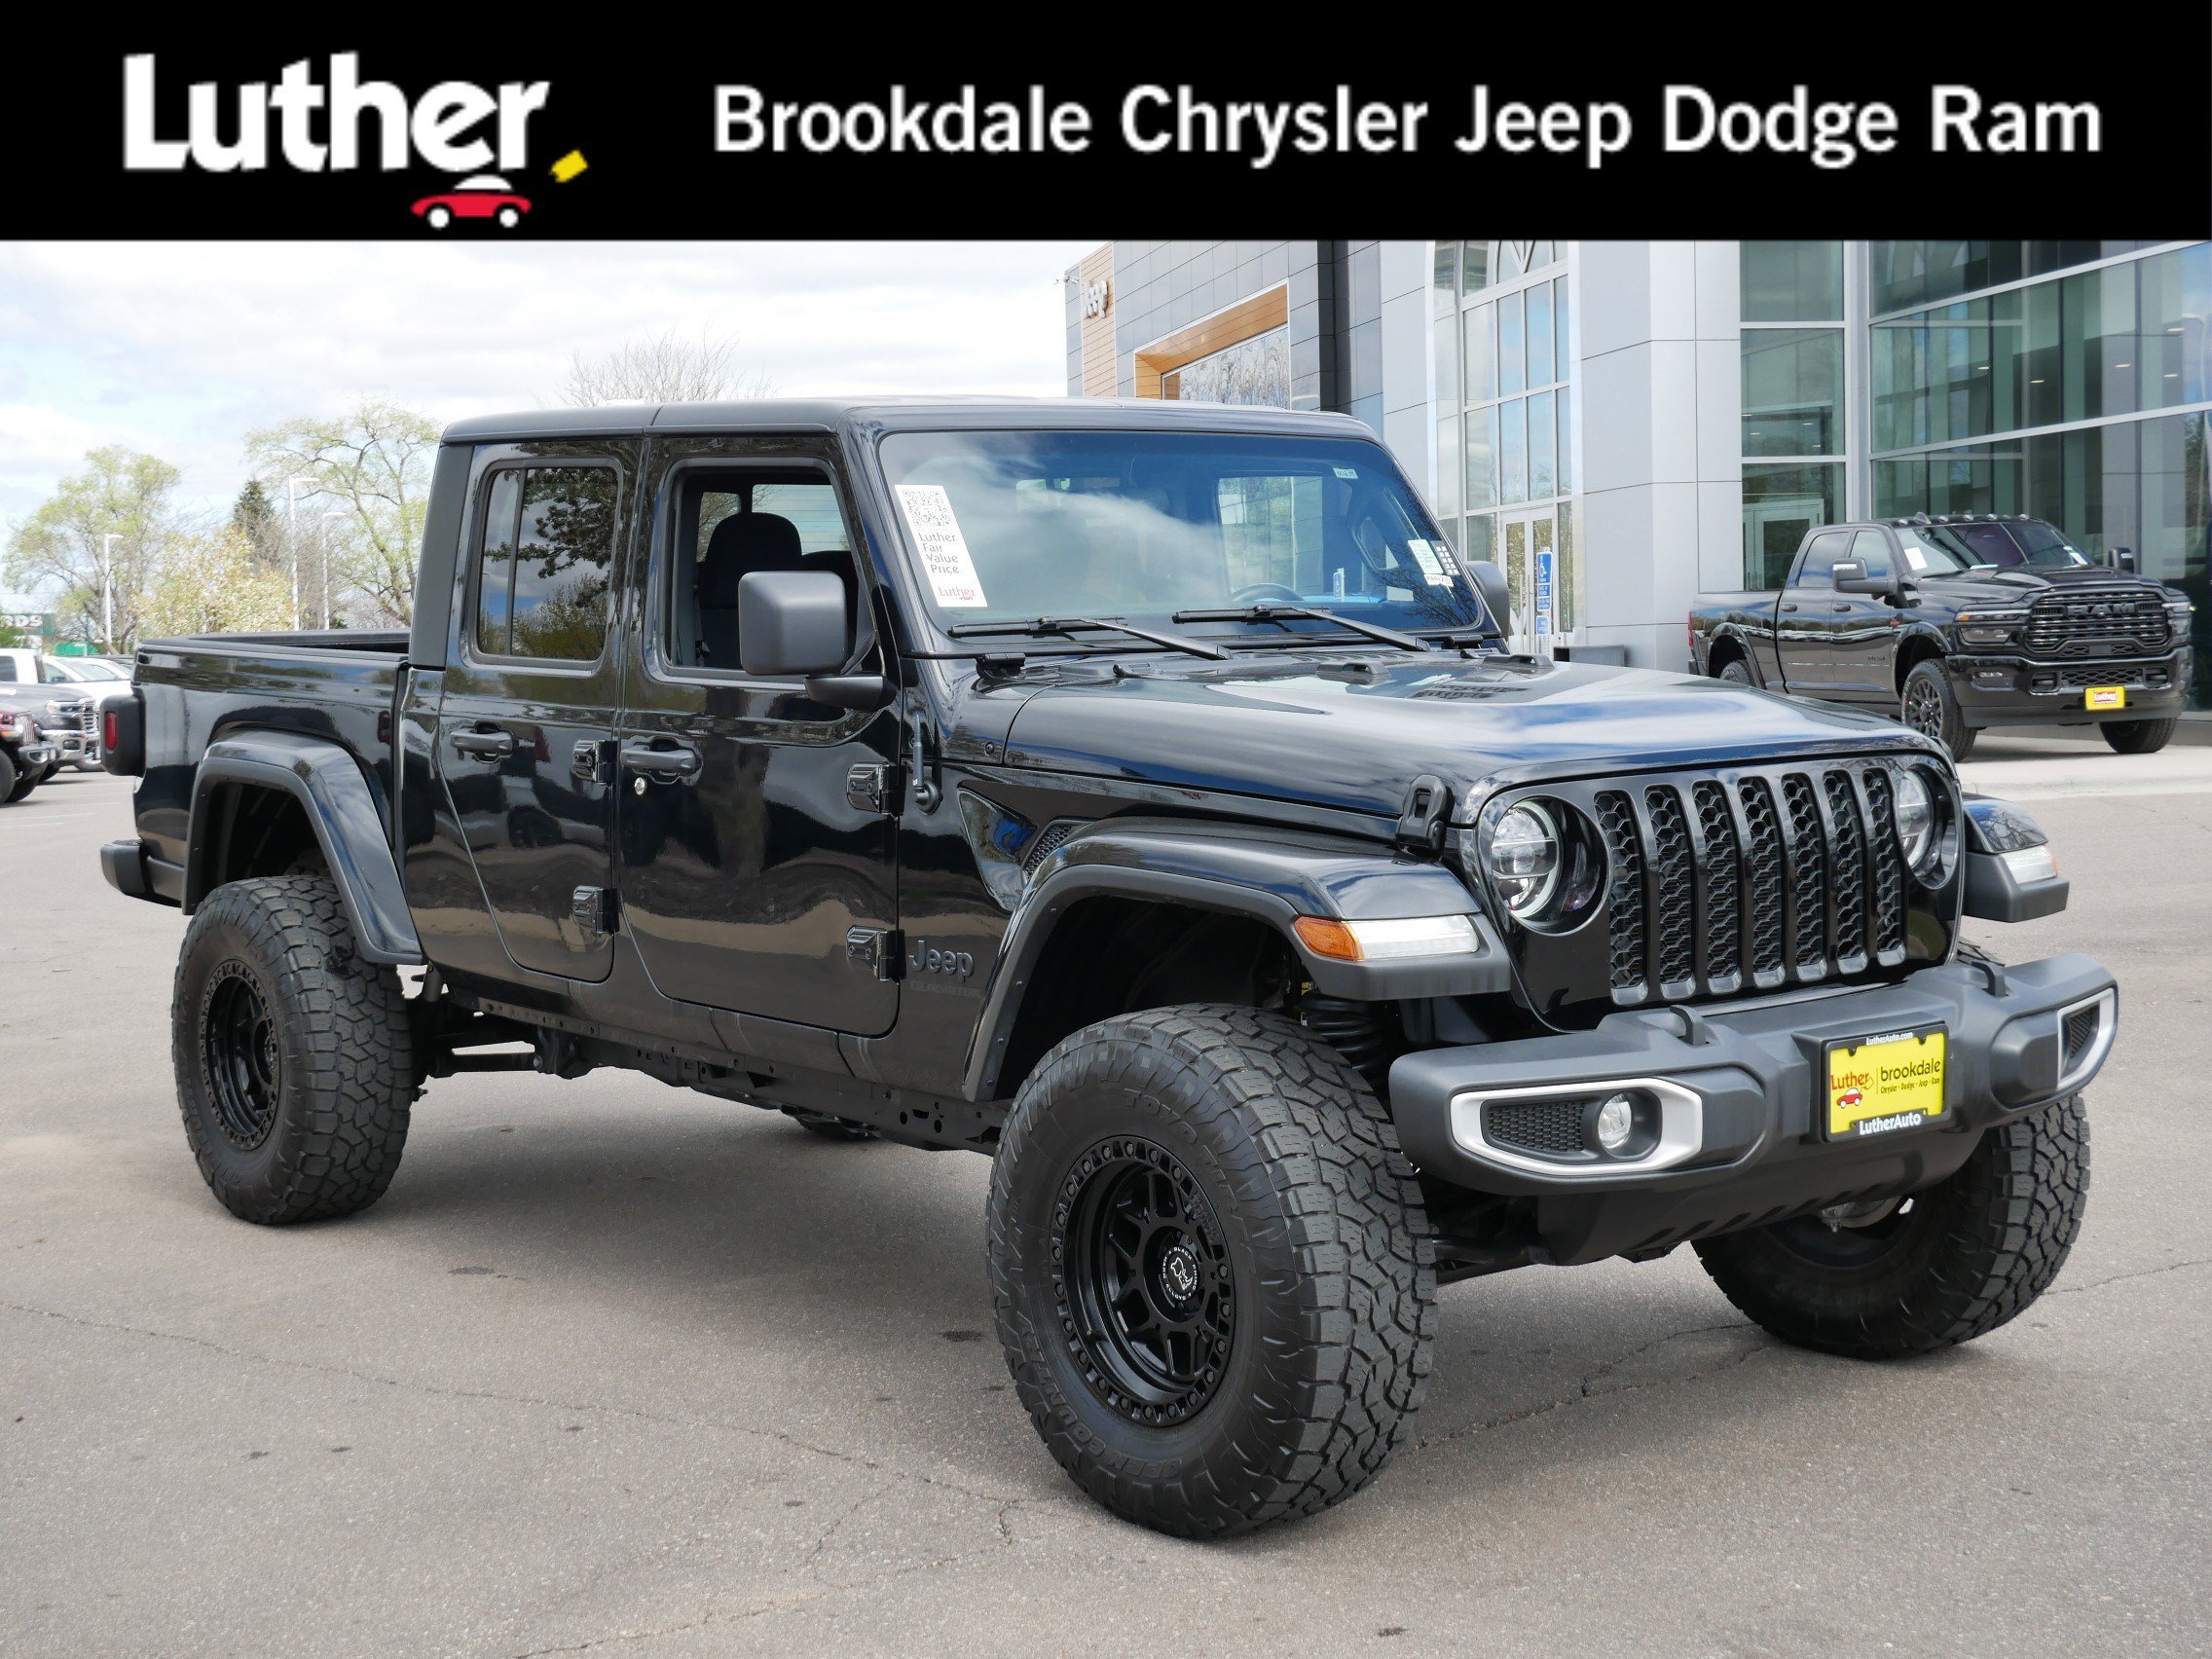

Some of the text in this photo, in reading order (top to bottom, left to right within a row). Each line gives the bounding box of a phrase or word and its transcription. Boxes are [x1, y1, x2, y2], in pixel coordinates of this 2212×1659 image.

[918, 532, 957, 542] Luther
[923, 542, 943, 552] Fair
[926, 553, 959, 564] Value
[930, 564, 960, 574] Price
[938, 586, 977, 598] Luther
[2067, 602, 2137, 616] RAM
[908, 939, 975, 984] Jeep
[1865, 1032, 1914, 1047] LutherAuto.com
[1830, 1057, 1941, 1090] Luther brookdale
[1859, 1112, 1922, 1136] LutherAuto
